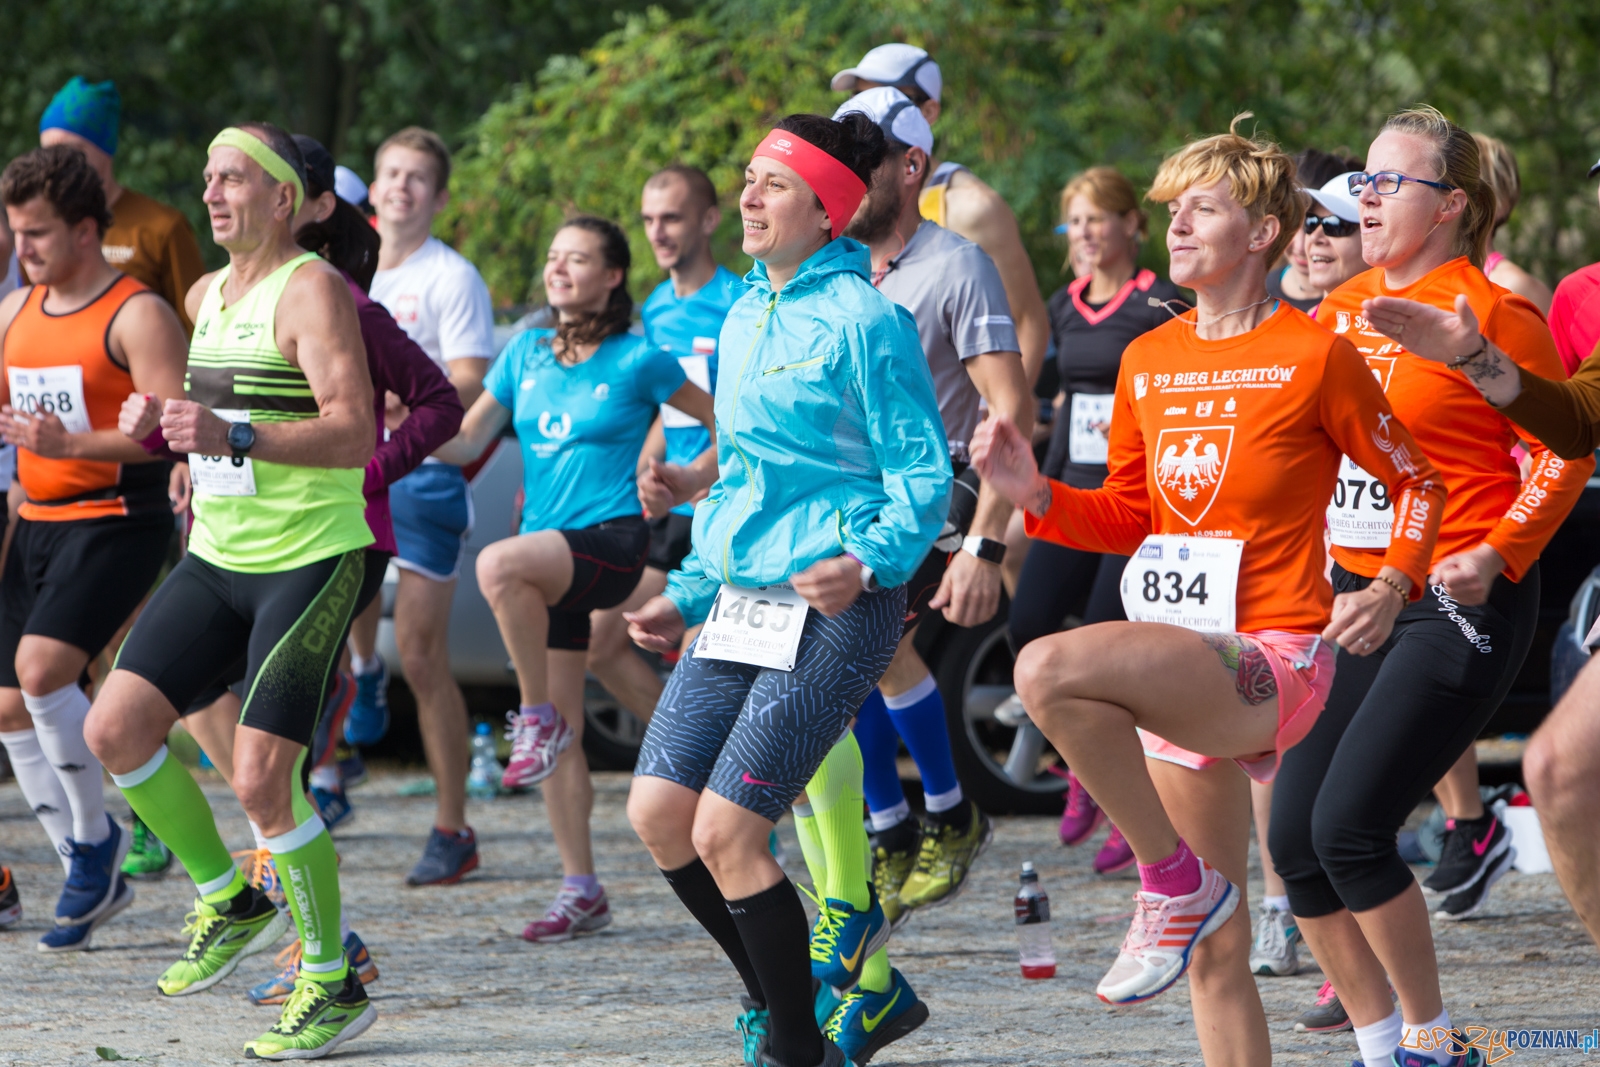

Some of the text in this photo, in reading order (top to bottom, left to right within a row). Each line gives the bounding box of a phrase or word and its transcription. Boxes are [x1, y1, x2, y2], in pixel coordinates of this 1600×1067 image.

[1355, 315, 1369, 331] 39
[1153, 364, 1297, 389] 39 BIEG LECHITÓW
[17, 391, 73, 415] 2068
[1329, 477, 1392, 511] 079
[1510, 485, 1548, 524] 2016
[1336, 518, 1351, 529] BIEG
[1404, 497, 1430, 541] 2016
[1142, 569, 1209, 606] 834
[301, 562, 356, 654] CRAFT
[711, 592, 795, 633] 1465
[1177, 616, 1223, 628] LECHITÓW
[721, 633, 741, 645] BIEG
